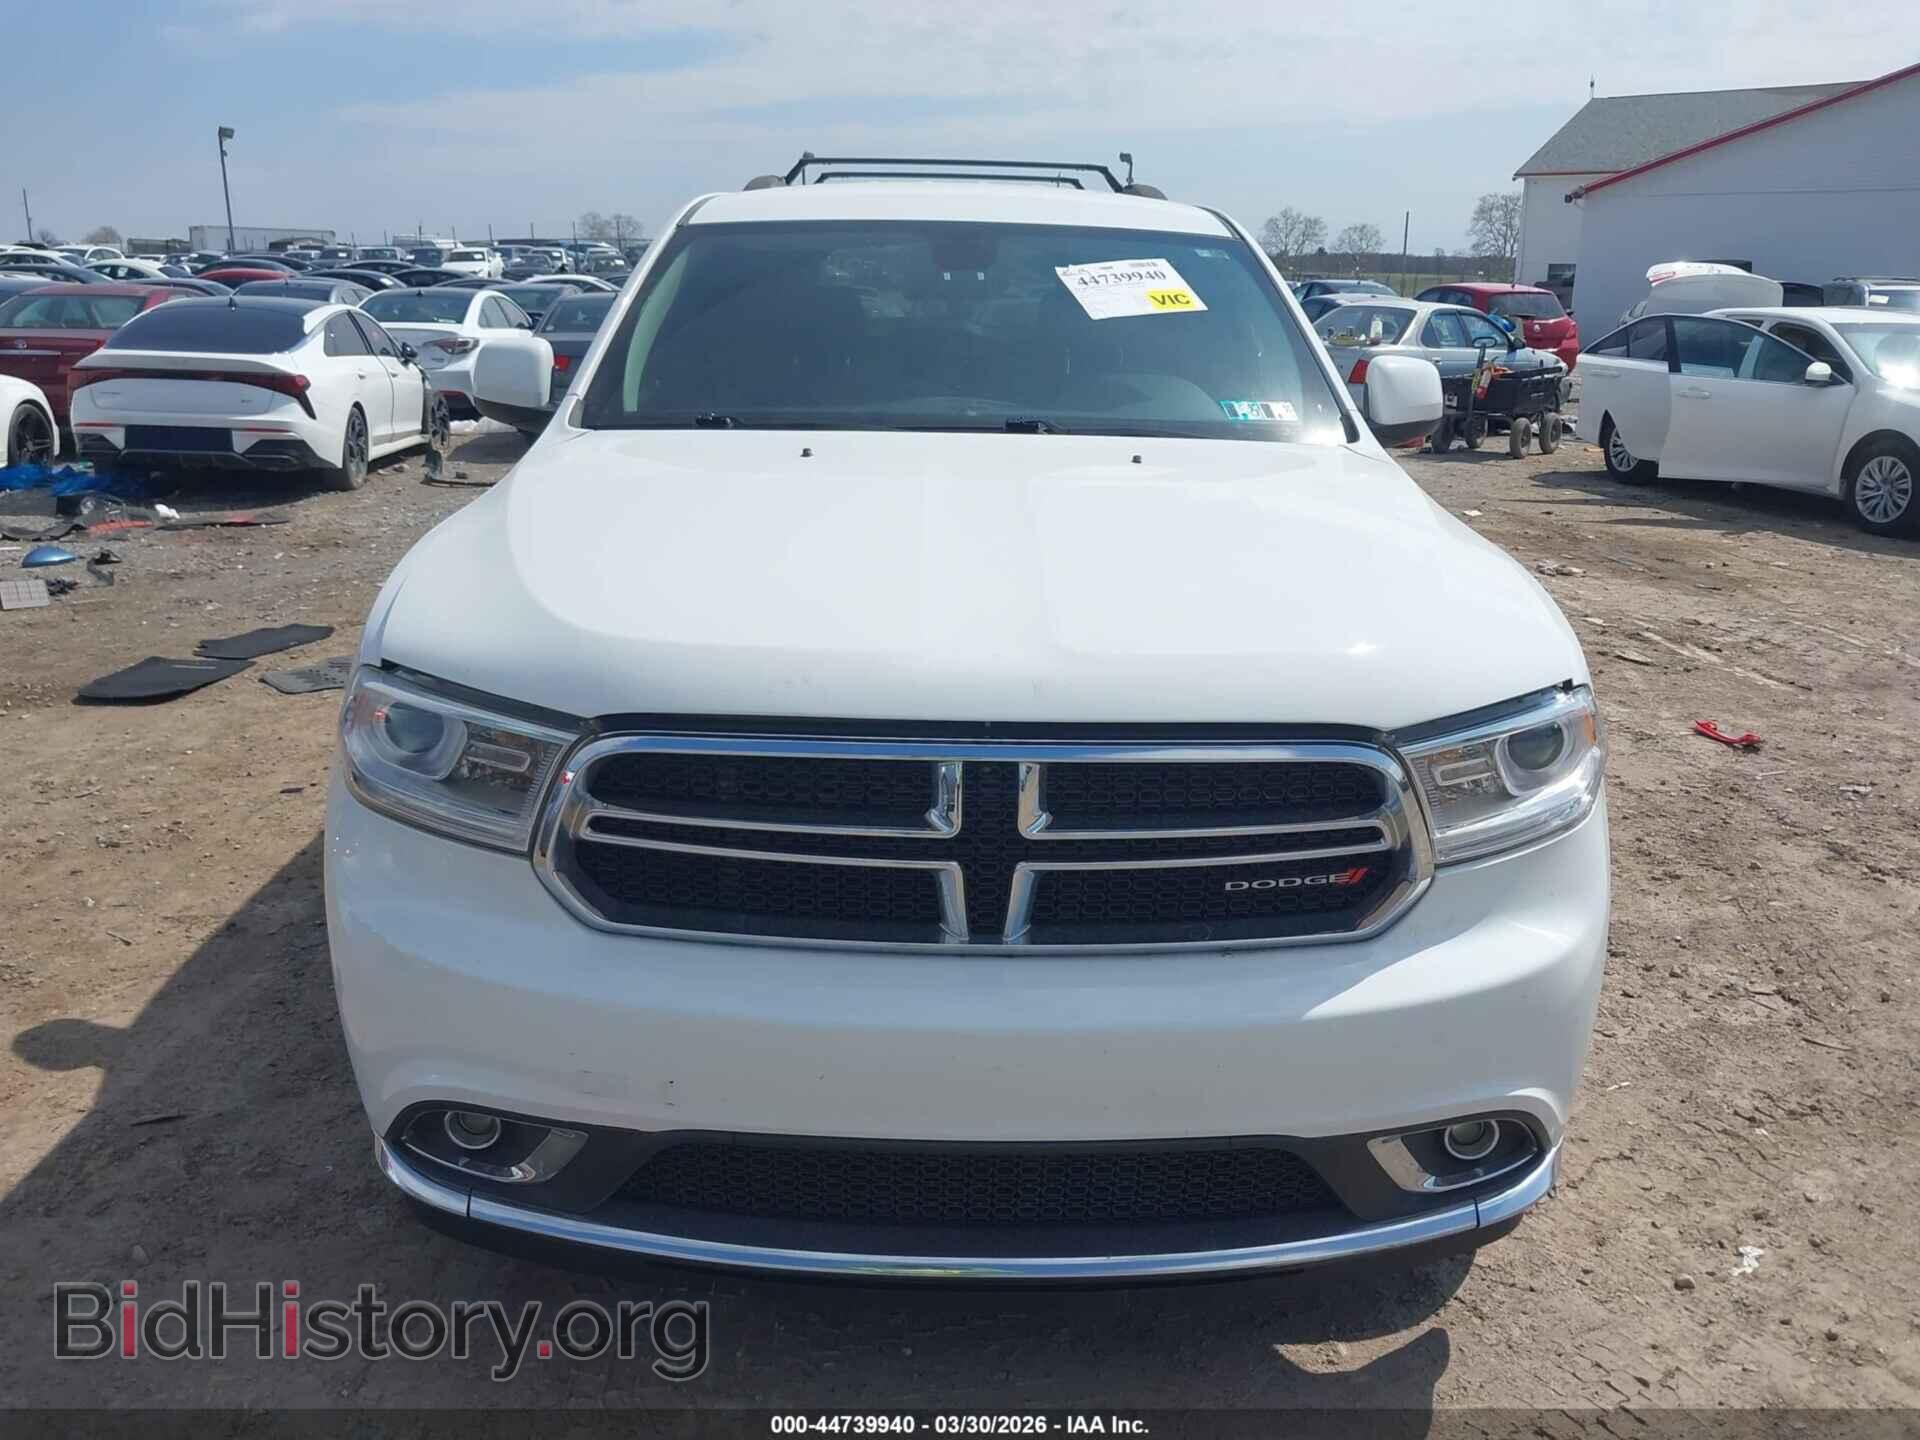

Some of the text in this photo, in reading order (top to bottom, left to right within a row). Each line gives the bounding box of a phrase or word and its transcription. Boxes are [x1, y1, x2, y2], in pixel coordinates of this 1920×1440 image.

[1077, 270, 1167, 287] 44739940
[1150, 292, 1191, 306] VIC
[1224, 872, 1351, 891] DODGE
